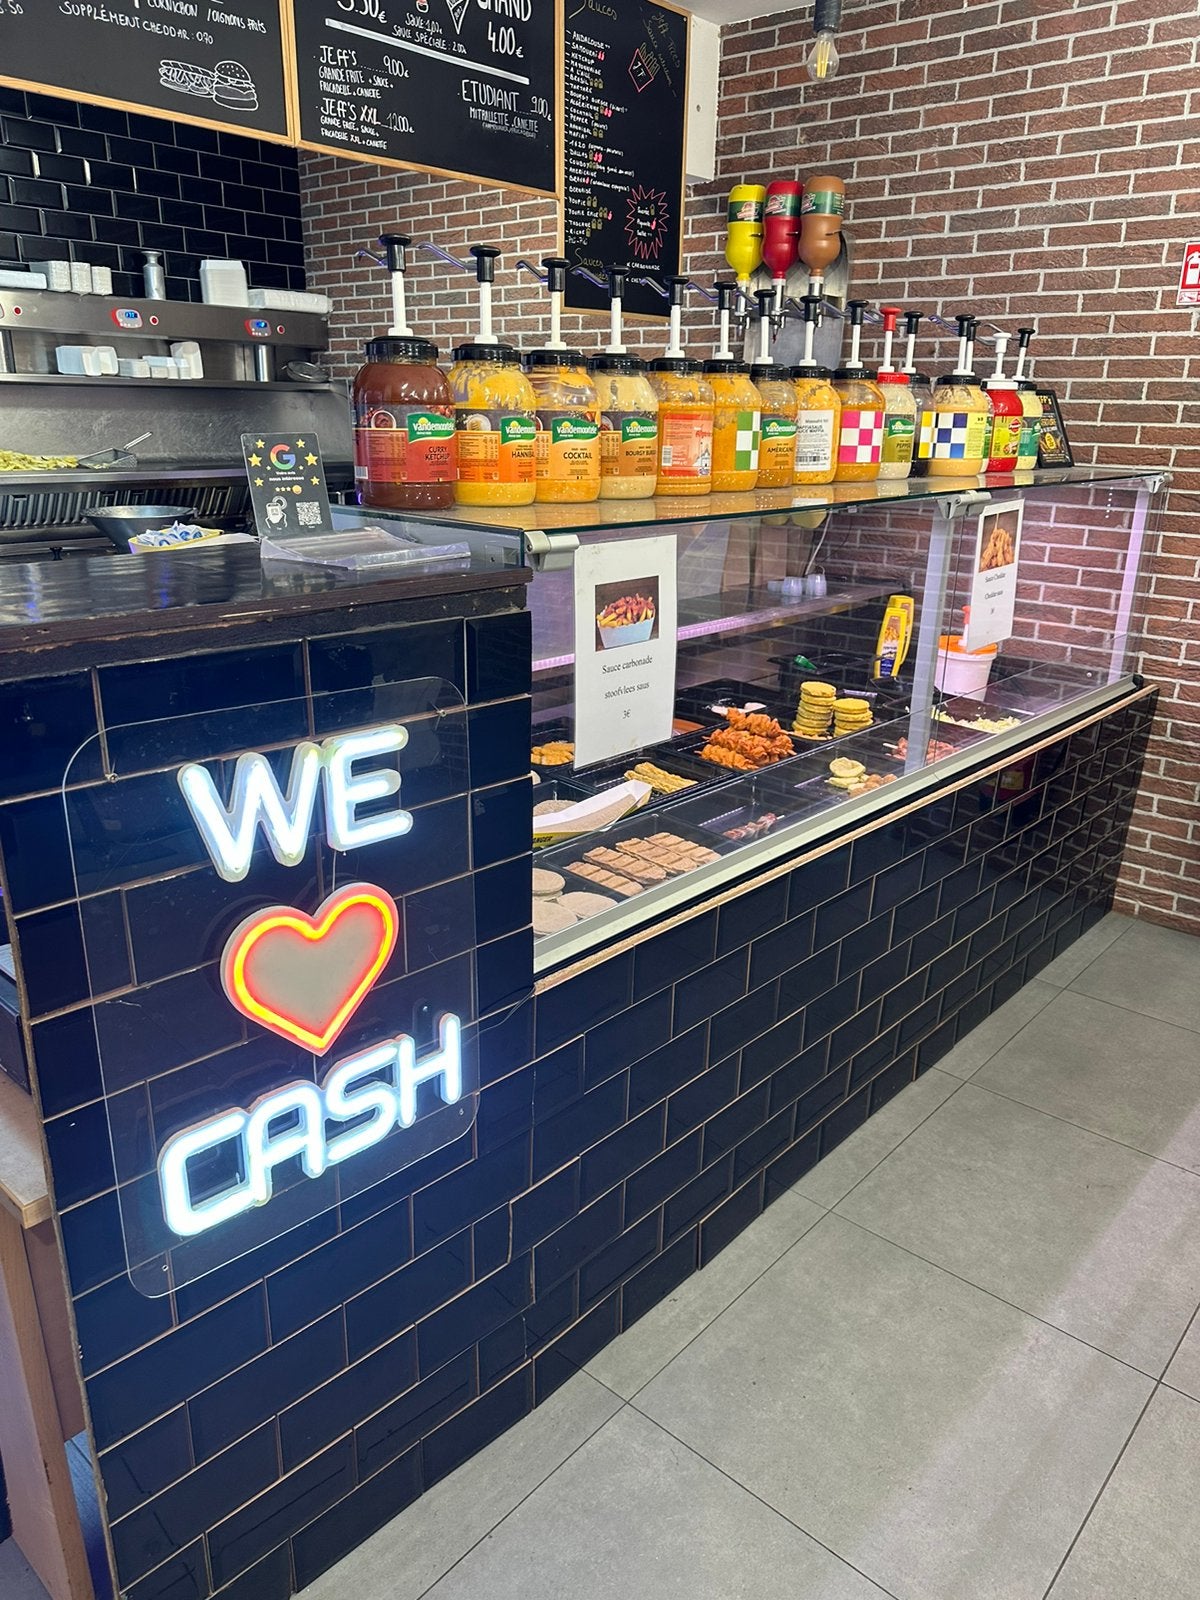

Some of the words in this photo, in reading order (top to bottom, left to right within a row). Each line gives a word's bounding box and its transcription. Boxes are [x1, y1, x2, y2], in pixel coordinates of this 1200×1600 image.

[461, 79, 520, 112] ETUDIANT
[360, 105, 381, 125] XXL
[602, 662, 622, 675] Sauce
[622, 655, 653, 671] carbonade
[604, 684, 636, 700] stoofvlees
[636, 681, 650, 694] saus
[177, 724, 413, 883] WE
[157, 1012, 462, 1236] CASH
